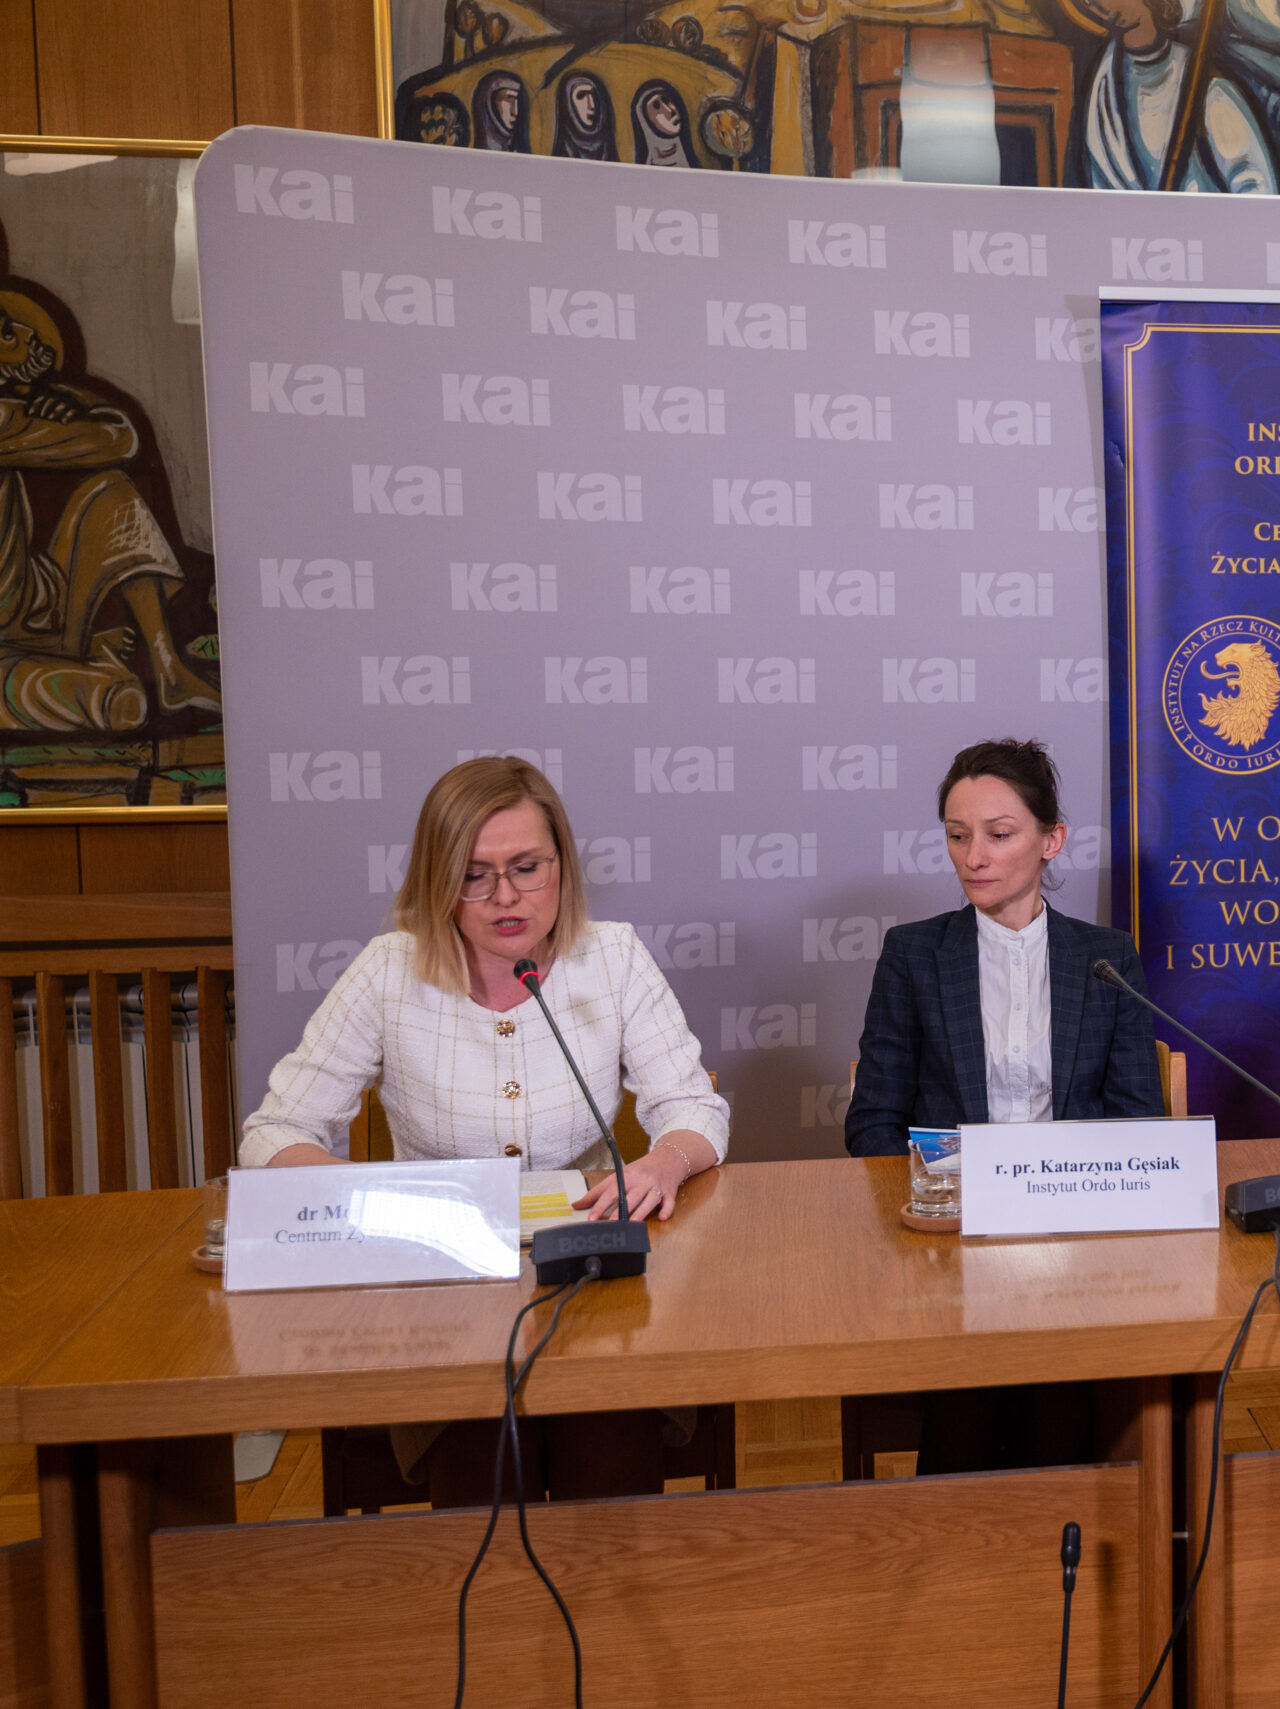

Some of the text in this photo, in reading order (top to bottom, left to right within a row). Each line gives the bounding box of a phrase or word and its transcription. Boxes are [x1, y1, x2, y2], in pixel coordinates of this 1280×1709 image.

[234, 164, 354, 224] kai
[432, 186, 542, 242] kai
[615, 206, 719, 257] kai
[788, 220, 886, 268] kai
[953, 230, 1047, 276] kai
[1112, 237, 1206, 282] kai
[341, 270, 455, 327] kai
[529, 287, 635, 340] kai
[706, 300, 807, 350] kai
[874, 310, 970, 358] kai
[1035, 317, 1101, 363] ka
[249, 361, 365, 417] kai
[442, 374, 551, 426] kai
[623, 384, 725, 435] kai
[794, 393, 892, 441] kai
[957, 399, 1051, 446] kai
[352, 465, 463, 515] kai
[538, 472, 642, 521] kai
[713, 479, 812, 526] kai
[879, 484, 974, 530] kai
[1038, 487, 1106, 533] ka
[259, 558, 374, 610] kai
[450, 563, 557, 612] kai
[630, 567, 730, 614] kai
[799, 570, 895, 616] kai
[961, 572, 1054, 617] kai
[361, 655, 471, 705] kai
[545, 656, 647, 705] kai
[718, 657, 815, 703] kai
[883, 658, 976, 703] kai
[1040, 657, 1109, 703] ka
[1167, 660, 1185, 732] INSTYTUT
[1181, 640, 1200, 659] NA
[1200, 620, 1244, 642] RZECZ
[269, 751, 382, 802] kai
[634, 746, 734, 793] kai
[803, 745, 897, 790] kai
[1192, 743, 1239, 769] ORDO
[882, 828, 957, 875] ka
[1211, 816, 1245, 842] W
[721, 833, 817, 879] kai
[1169, 854, 1280, 886] ŻYCIA,
[276, 939, 363, 992] ka
[1166, 945, 1175, 970] I
[721, 1003, 816, 1051] kai
[995, 1156, 1181, 1178] r. pr. Katarzyna Gęsiak
[1026, 1176, 1151, 1196] Instytut Ordo Iuris
[275, 1229, 342, 1244] Centrum
[297, 1206, 319, 1221] dr
[559, 1231, 626, 1253] BOSCH
